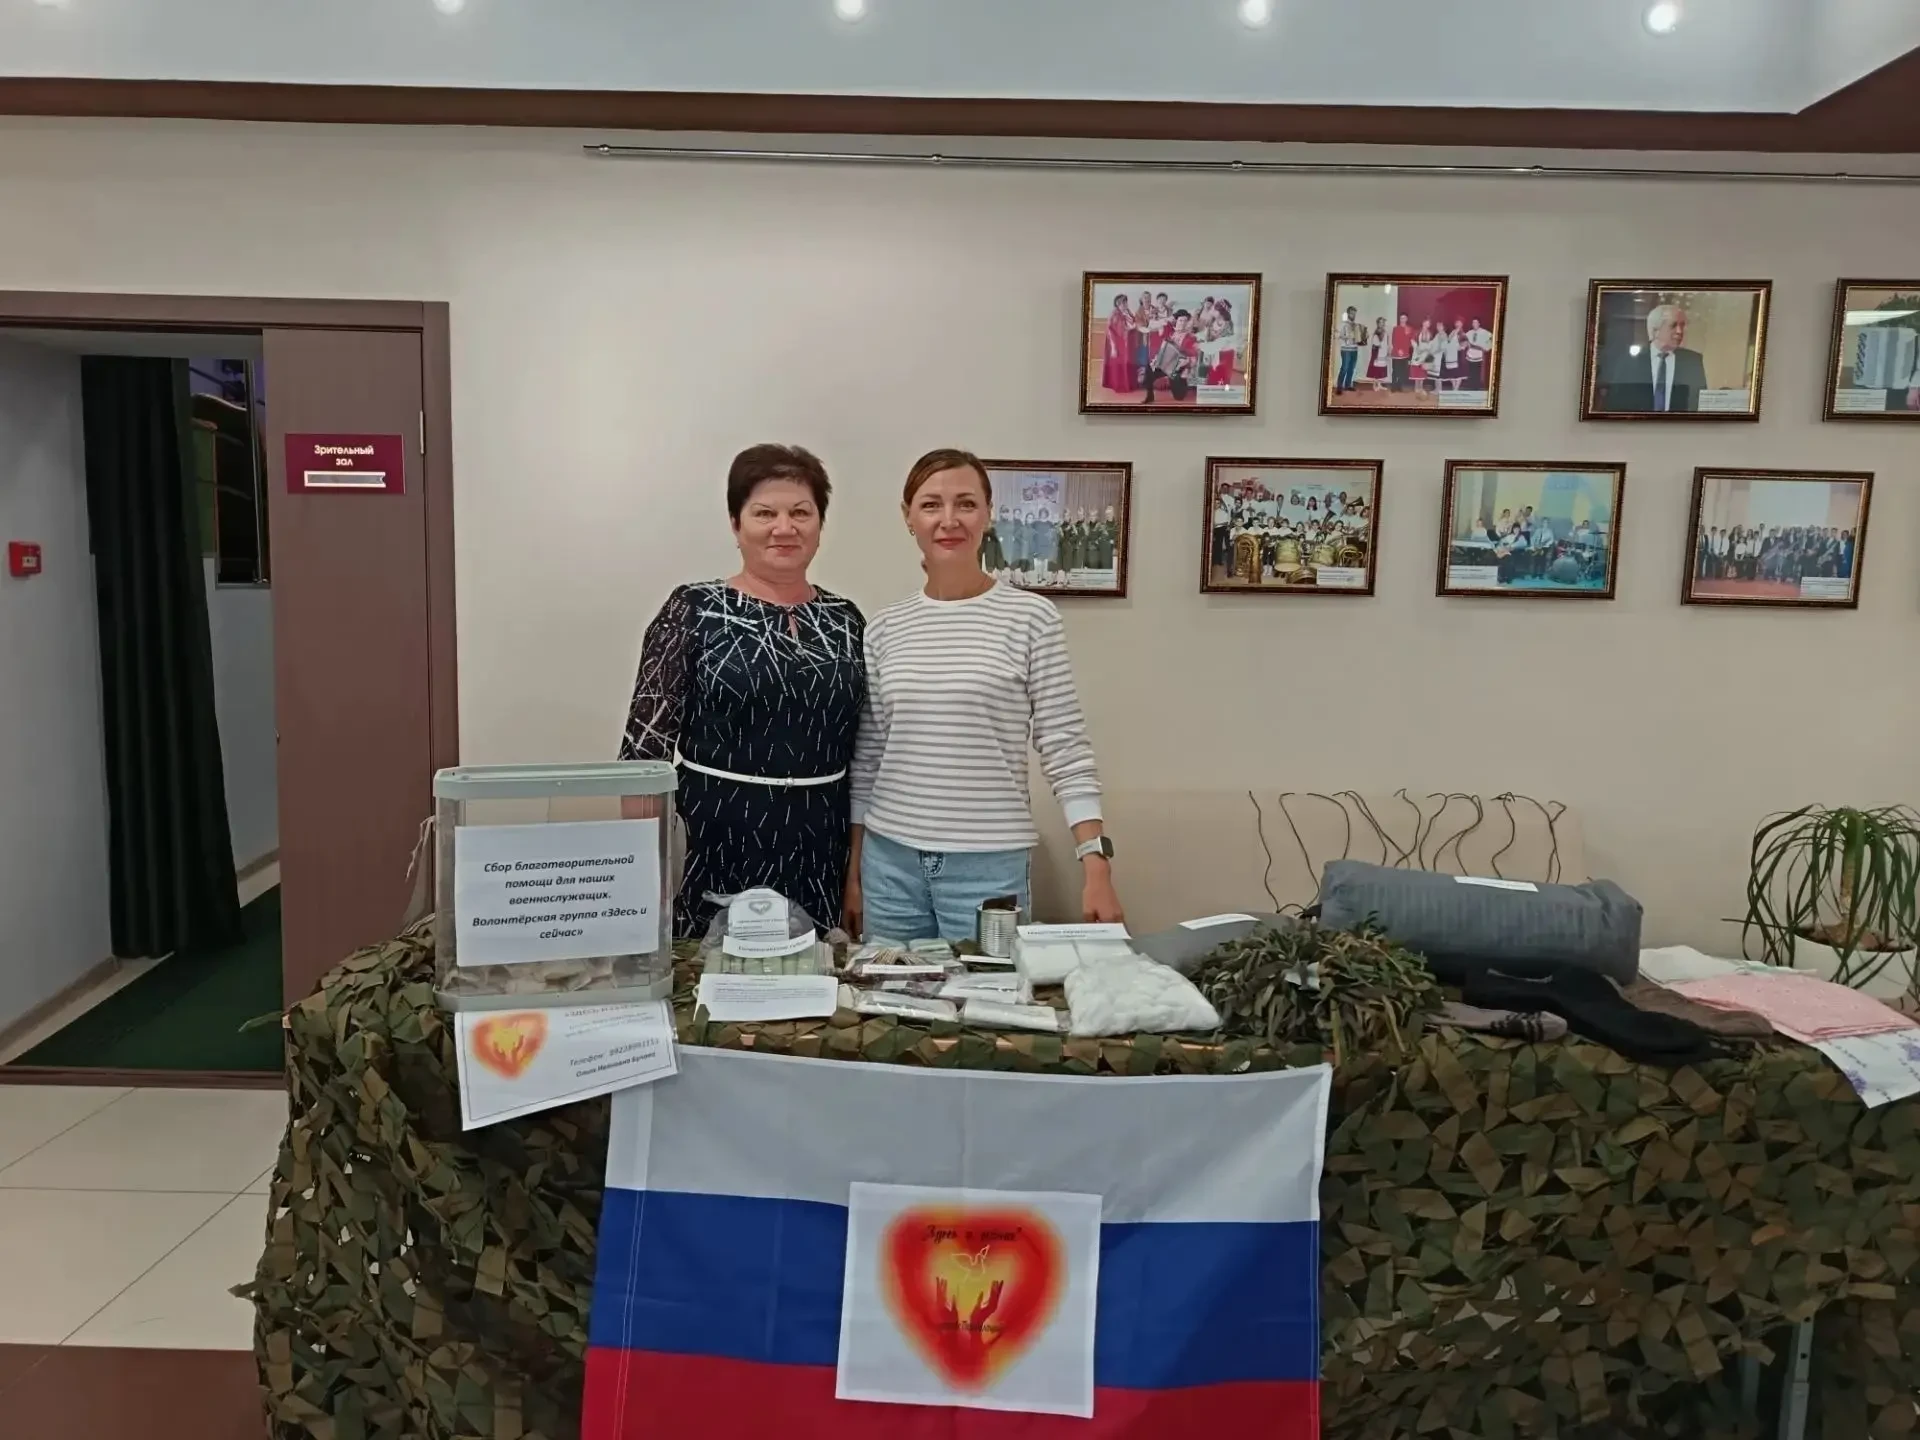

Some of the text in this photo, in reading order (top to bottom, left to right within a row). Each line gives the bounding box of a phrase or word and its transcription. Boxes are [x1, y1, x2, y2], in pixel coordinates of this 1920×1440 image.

[314, 444, 374, 456] Зрительный
[335, 458, 353, 466] зал
[484, 854, 635, 873] Сбор благотворительной
[505, 873, 615, 889] помощи для наших
[509, 891, 612, 906] военнослужащих.
[472, 906, 647, 927] Волонтёрская группа «Здесь и
[539, 928, 584, 939] сейчас»
